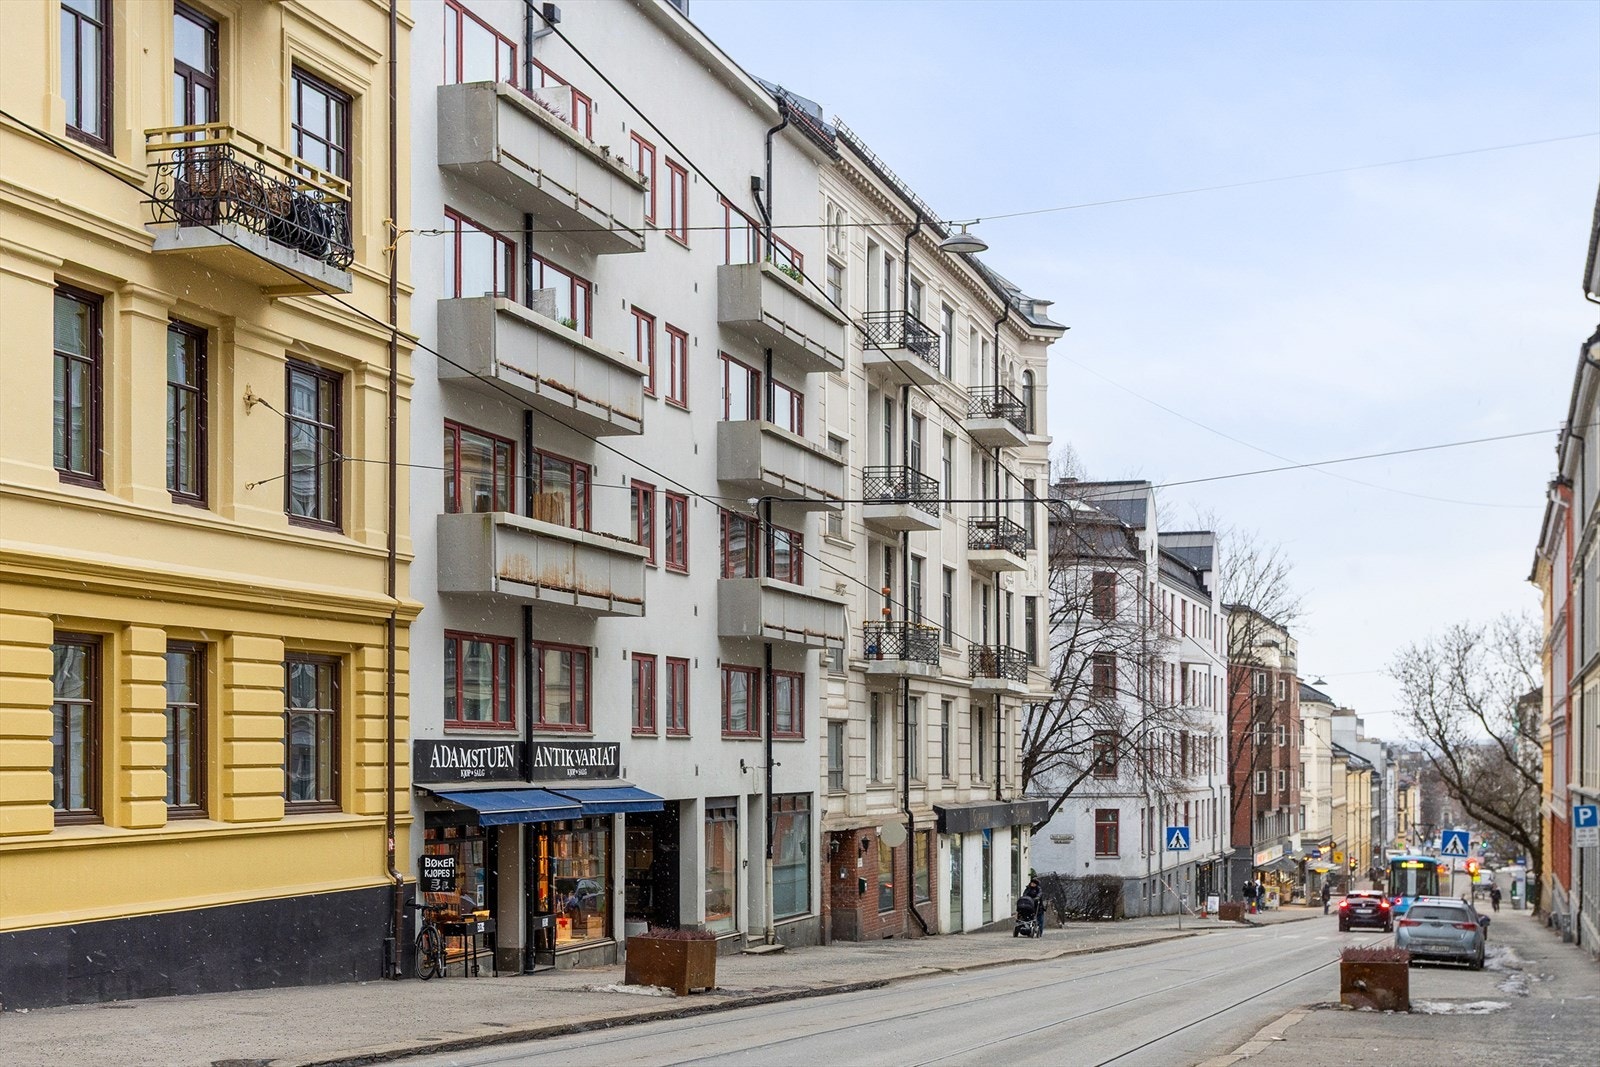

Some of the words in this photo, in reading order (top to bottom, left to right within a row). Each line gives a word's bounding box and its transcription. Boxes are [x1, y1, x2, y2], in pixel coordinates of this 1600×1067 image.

[430, 744, 515, 768] ADAMSTUEN
[534, 746, 616, 767] ANTIKVARIAT
[1579, 808, 1592, 826] P
[424, 858, 454, 868] BØKER
[424, 870, 450, 878] KJØPES
